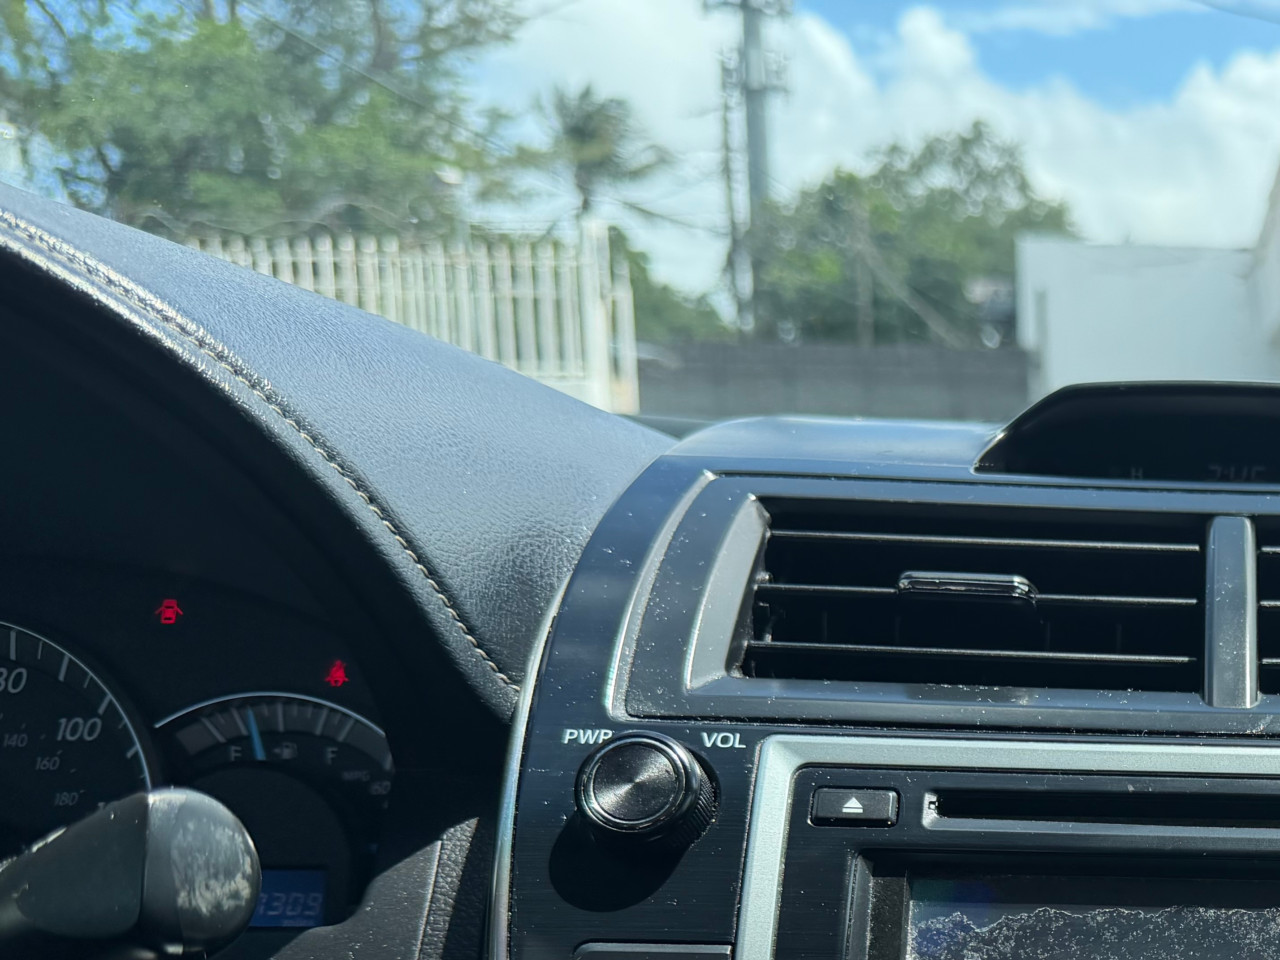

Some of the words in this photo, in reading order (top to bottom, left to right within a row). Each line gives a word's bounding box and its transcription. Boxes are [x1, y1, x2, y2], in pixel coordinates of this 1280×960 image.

[56, 717, 103, 742] 100
[3, 733, 29, 748] 140
[700, 731, 747, 749] VOL
[35, 756, 61, 771] 160
[326, 746, 339, 765] F
[54, 792, 79, 806] 180
